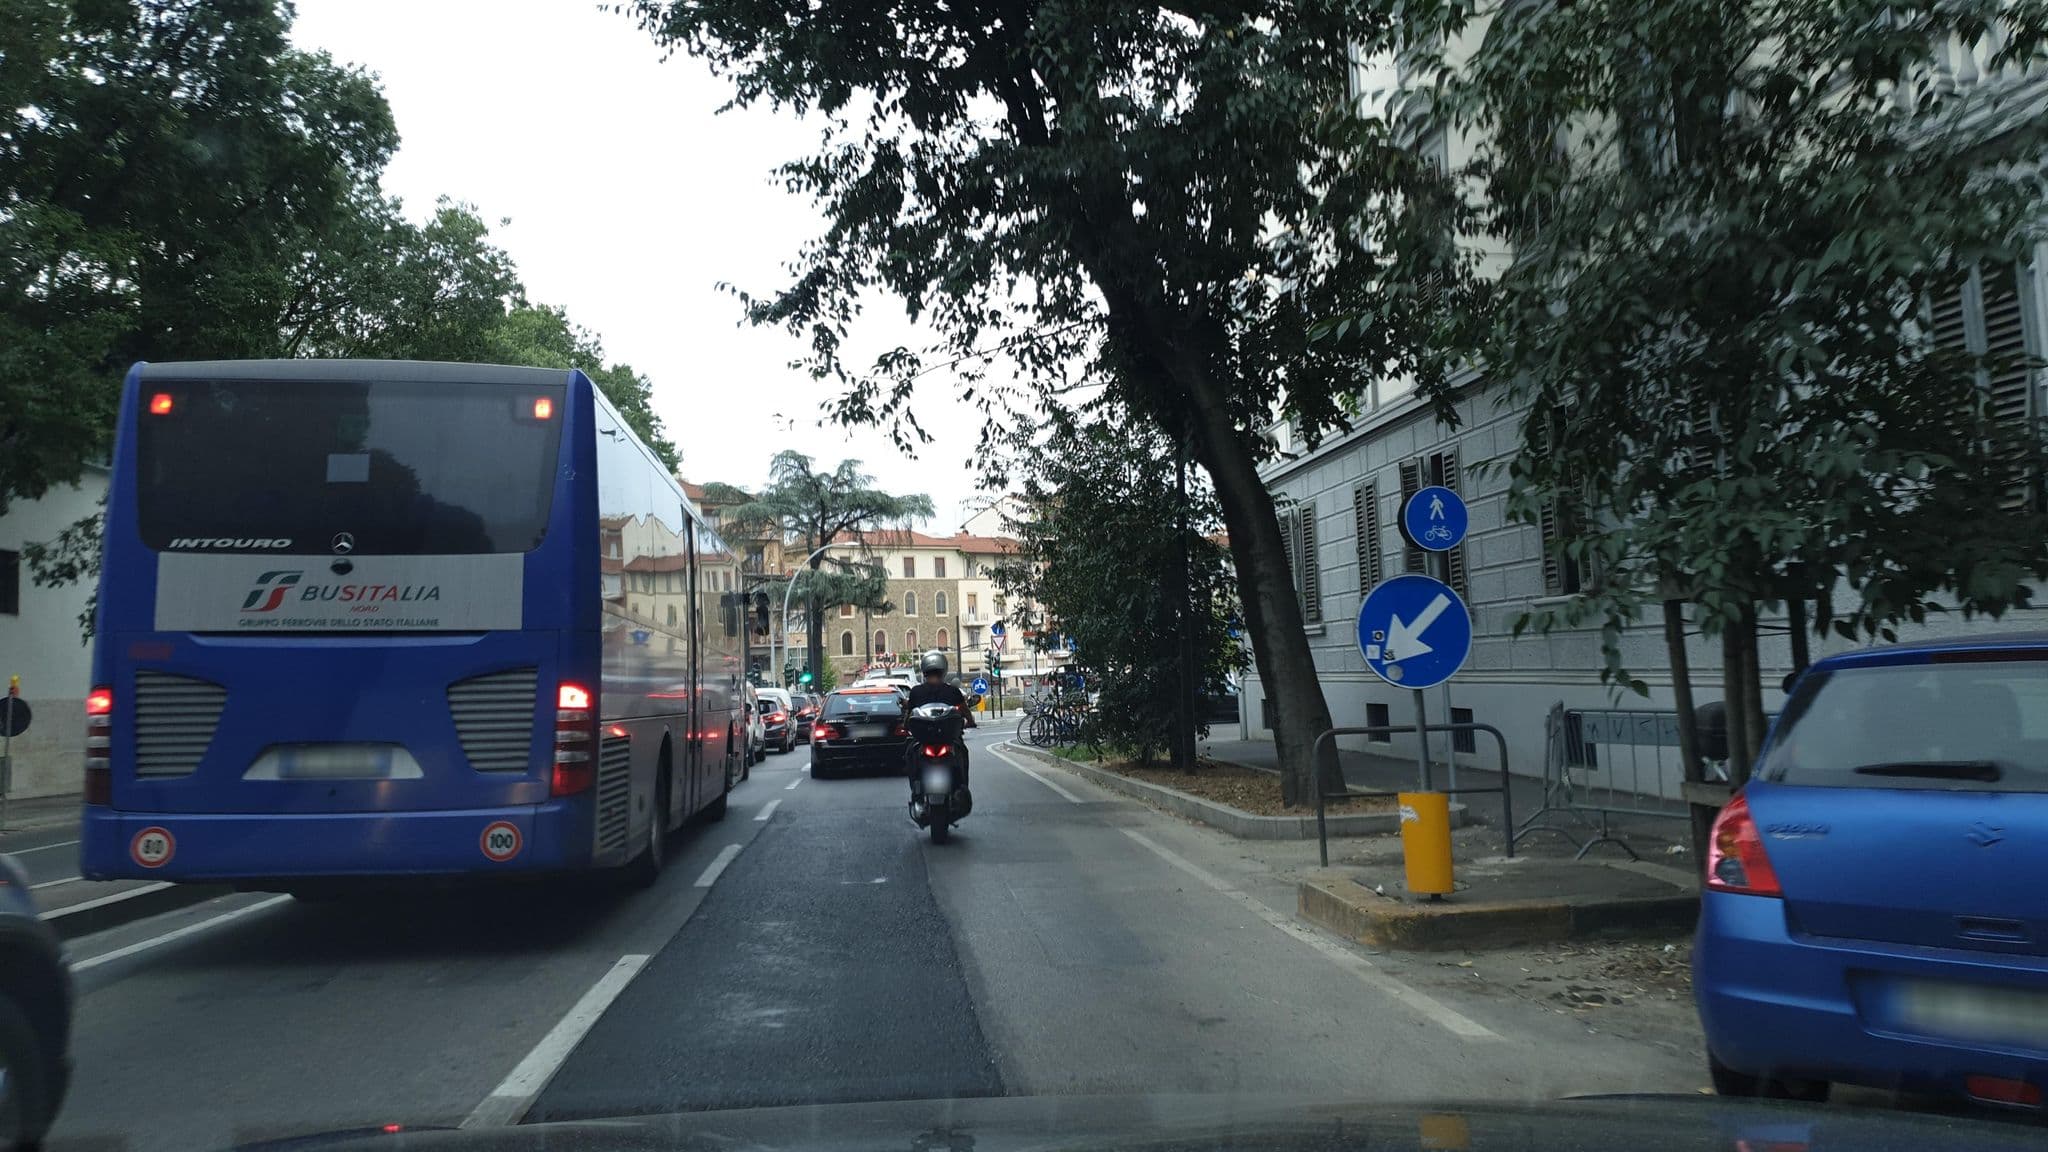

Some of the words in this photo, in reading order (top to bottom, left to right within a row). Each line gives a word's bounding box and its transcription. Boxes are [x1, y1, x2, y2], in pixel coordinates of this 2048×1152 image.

[168, 537, 293, 549] INTOURO
[301, 585, 441, 601] BUSITALIA
[239, 617, 279, 627] GRUPPO
[281, 617, 327, 627] FERROVIE
[330, 617, 360, 627] DELLO
[363, 617, 393, 627] STATO
[396, 617, 440, 627] ITALIANE
[489, 833, 514, 849] 100
